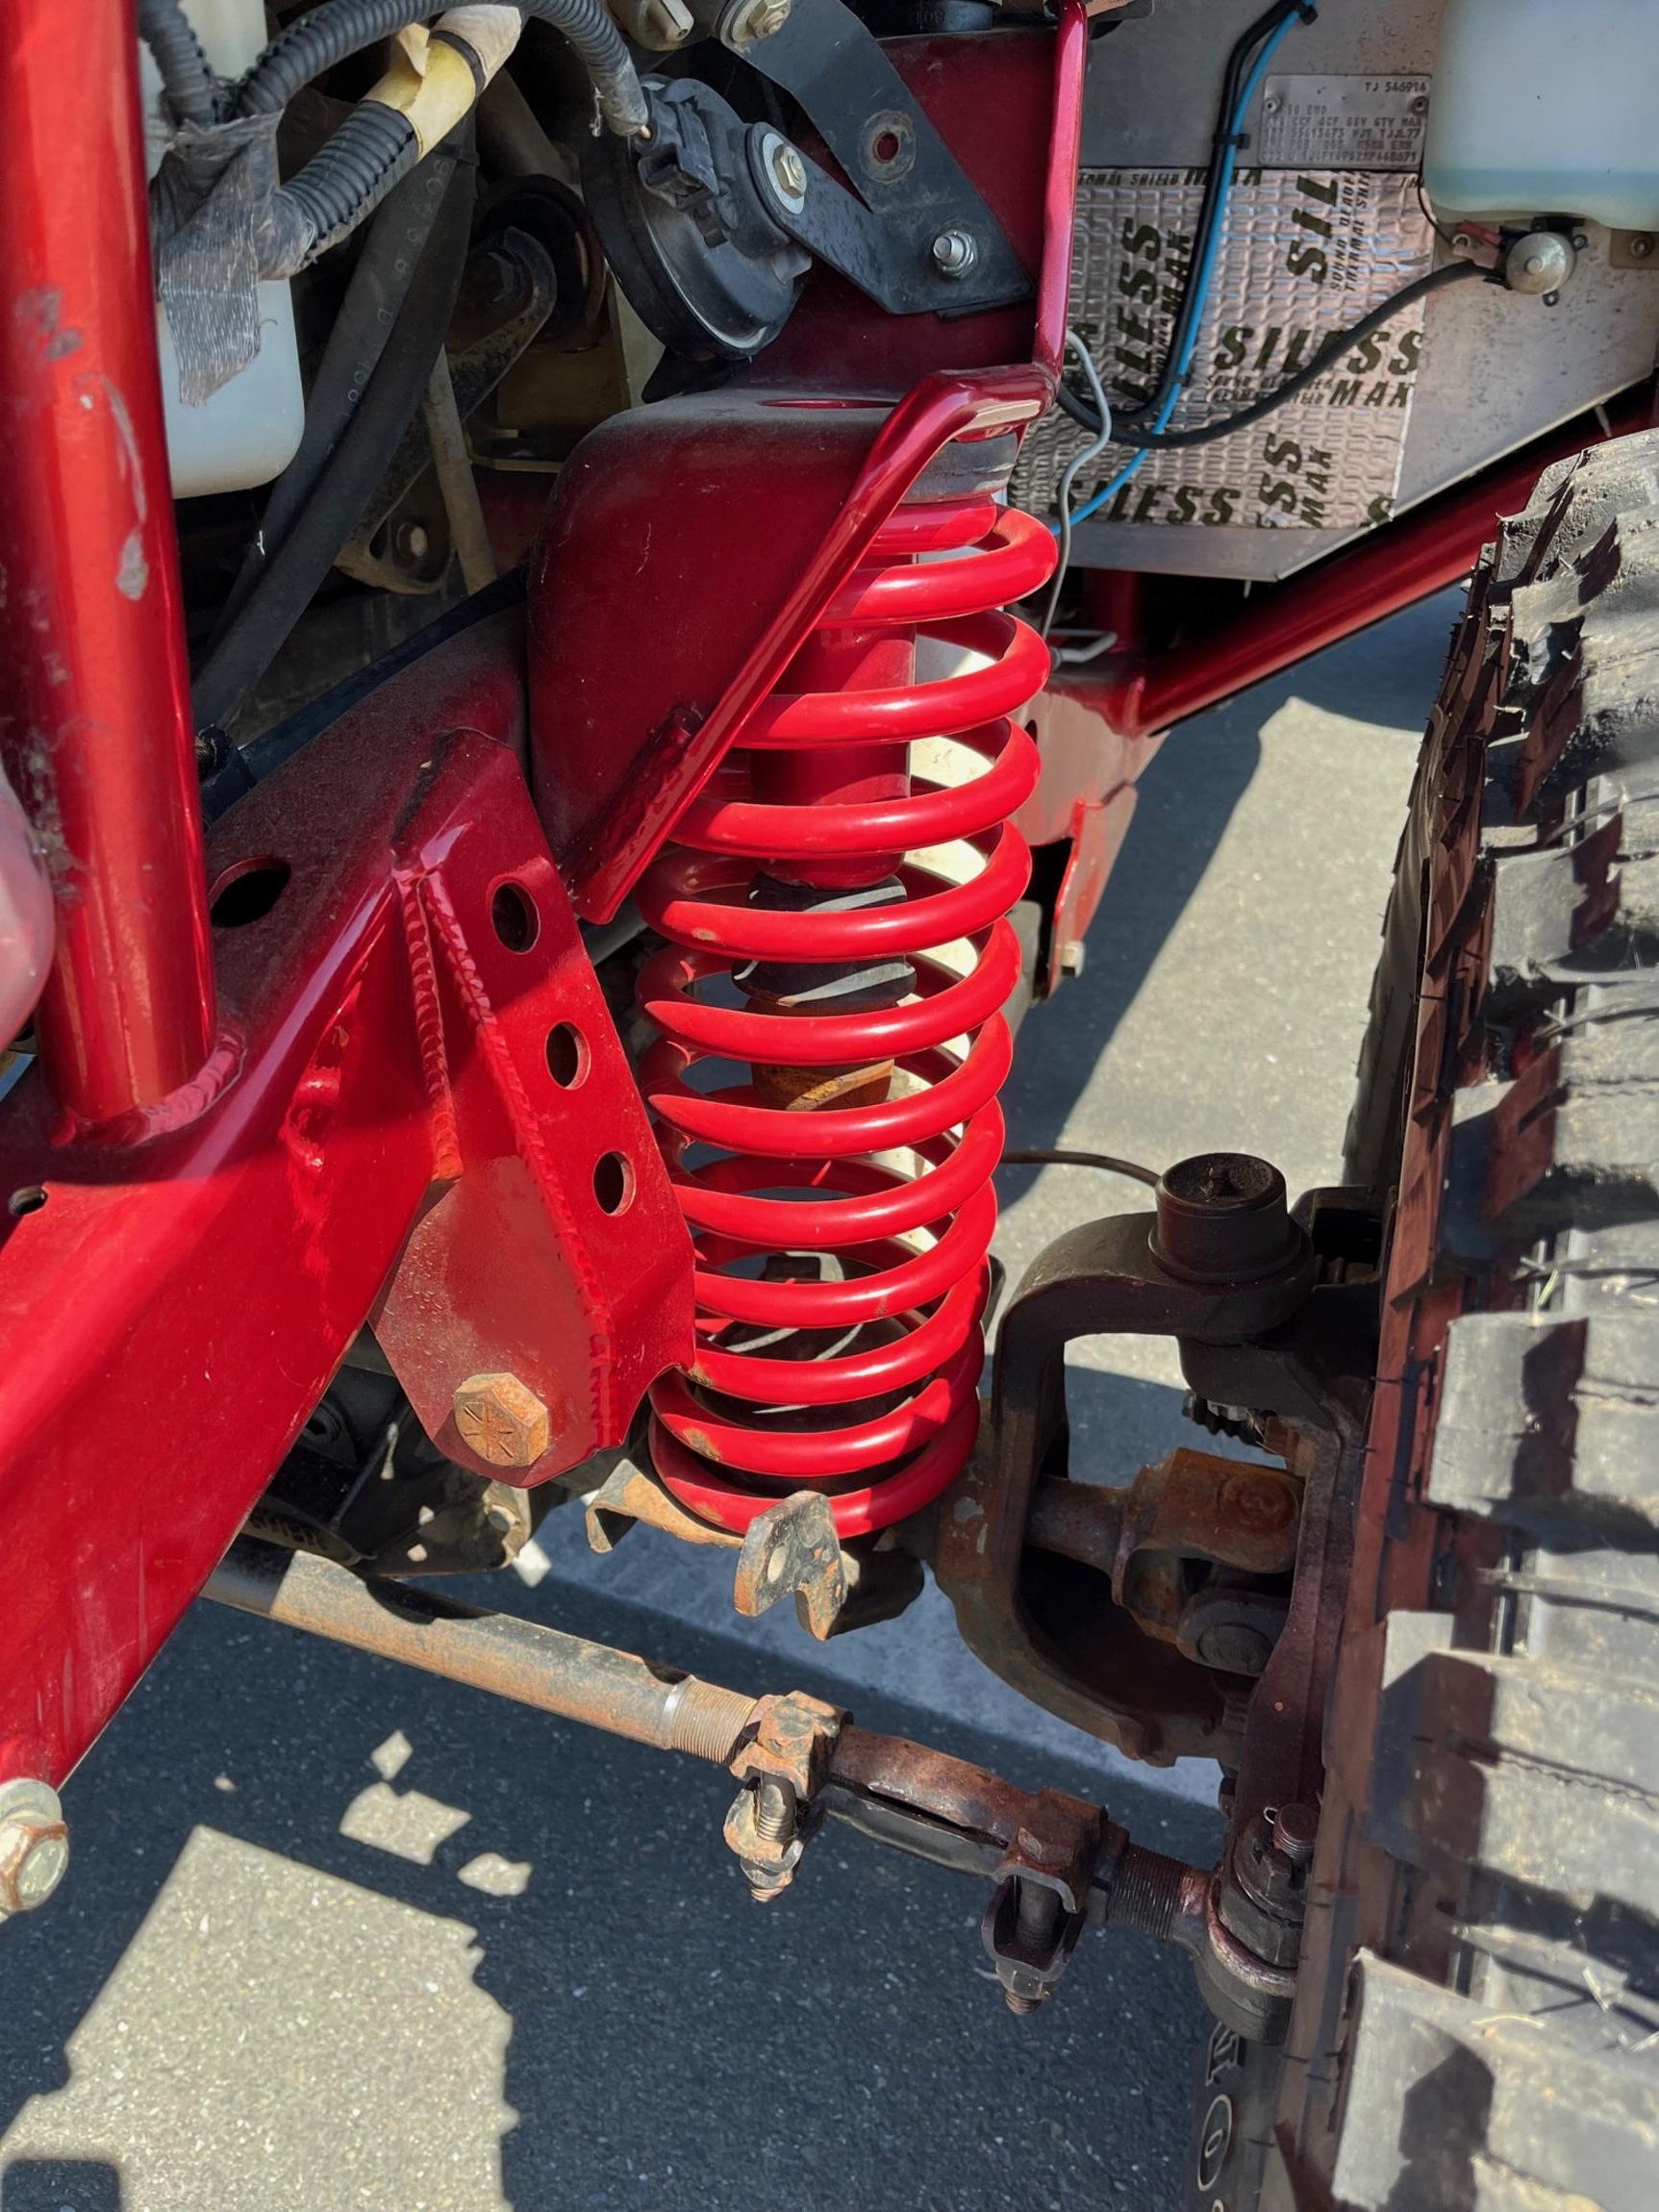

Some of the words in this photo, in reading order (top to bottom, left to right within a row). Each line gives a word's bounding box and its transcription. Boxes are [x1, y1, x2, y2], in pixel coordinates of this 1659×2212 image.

[1365, 81, 1379, 92] TJ
[1130, 172, 1181, 187] SHIELD
[1286, 174, 1339, 286] SIL
[1345, 219, 1366, 292] THERMAL
[1356, 171, 1372, 210] SHIE
[1330, 239, 1347, 291] SOUND
[1112, 216, 1162, 402] ILESS
[1328, 379, 1410, 408] MAX
[1300, 444, 1332, 529] MAX
